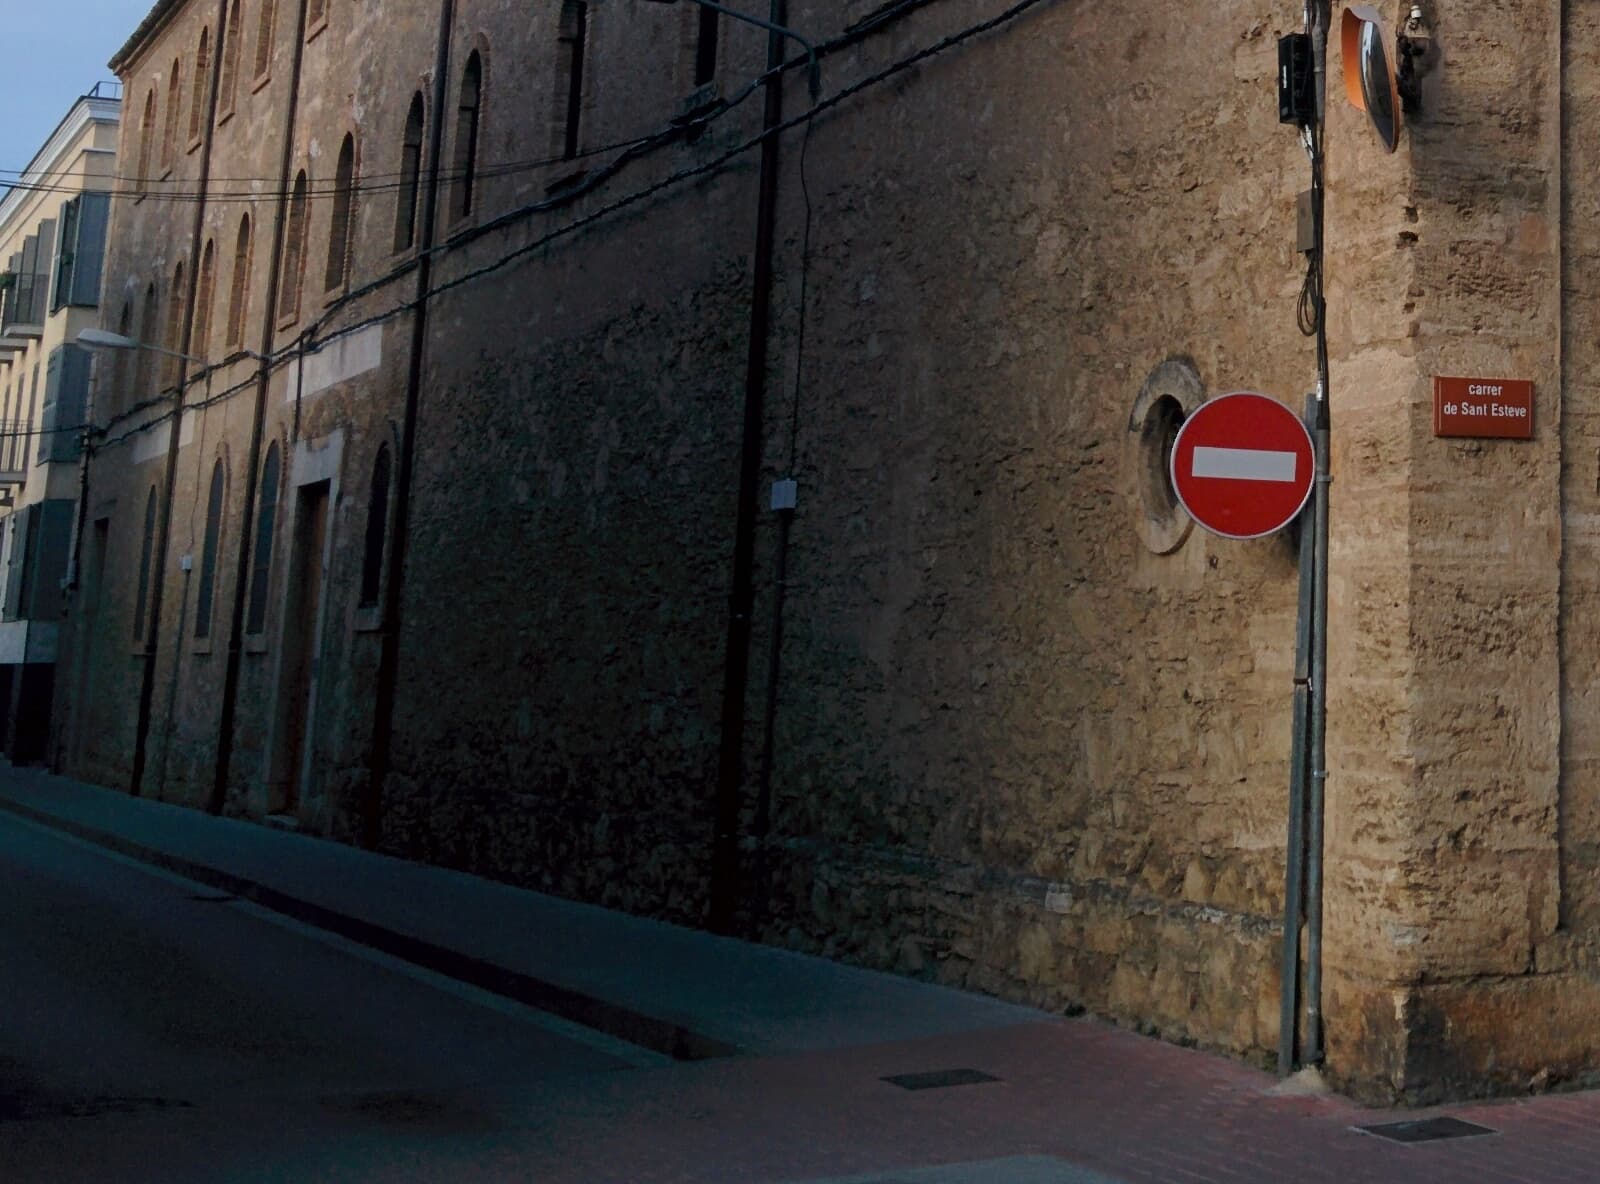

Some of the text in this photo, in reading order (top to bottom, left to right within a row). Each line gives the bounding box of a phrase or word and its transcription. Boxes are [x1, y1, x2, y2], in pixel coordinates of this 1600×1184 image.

[1468, 384, 1503, 396] carrer
[1443, 401, 1527, 417] de Sant Esteve
